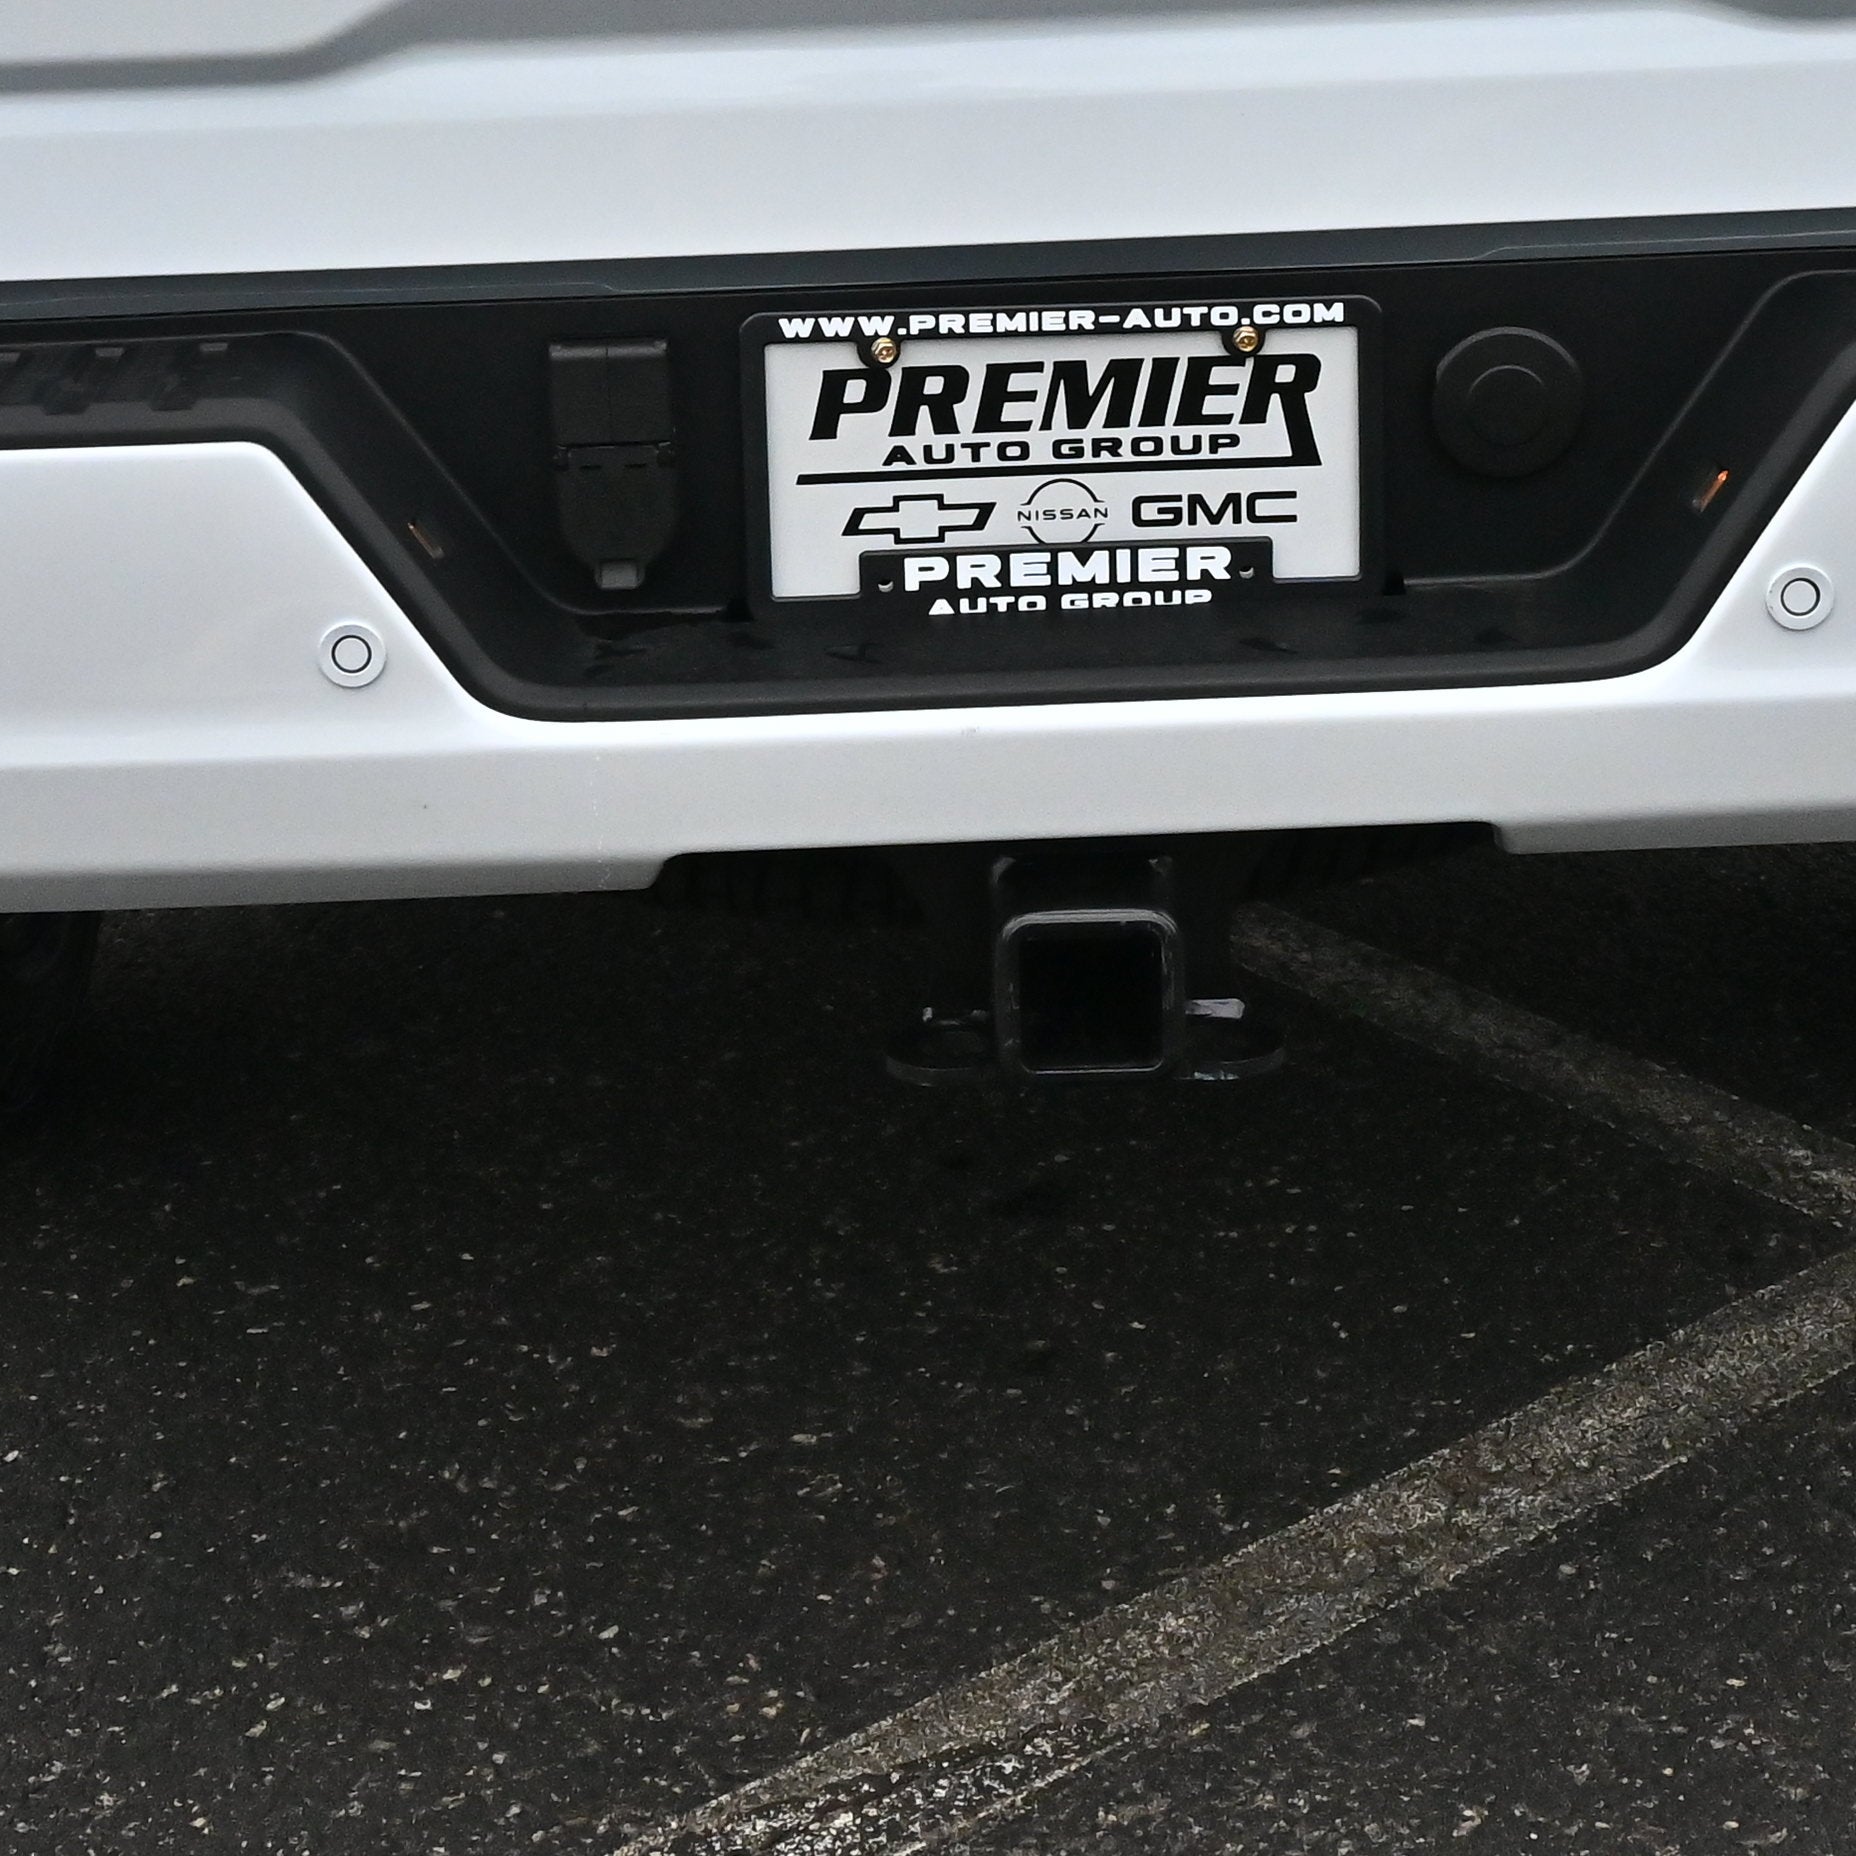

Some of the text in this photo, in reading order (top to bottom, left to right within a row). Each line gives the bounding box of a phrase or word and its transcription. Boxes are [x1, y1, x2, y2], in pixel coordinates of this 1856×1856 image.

[779, 302, 1345, 339] WWW.PREMIER-AUTO.COM
[809, 353, 1323, 466] PREMIER
[882, 433, 1242, 466] AUTO GROUP
[1017, 490, 1298, 527] NISSAN GMC
[904, 546, 1232, 592] PREMIER
[928, 589, 1213, 616] AUTO GROUP
